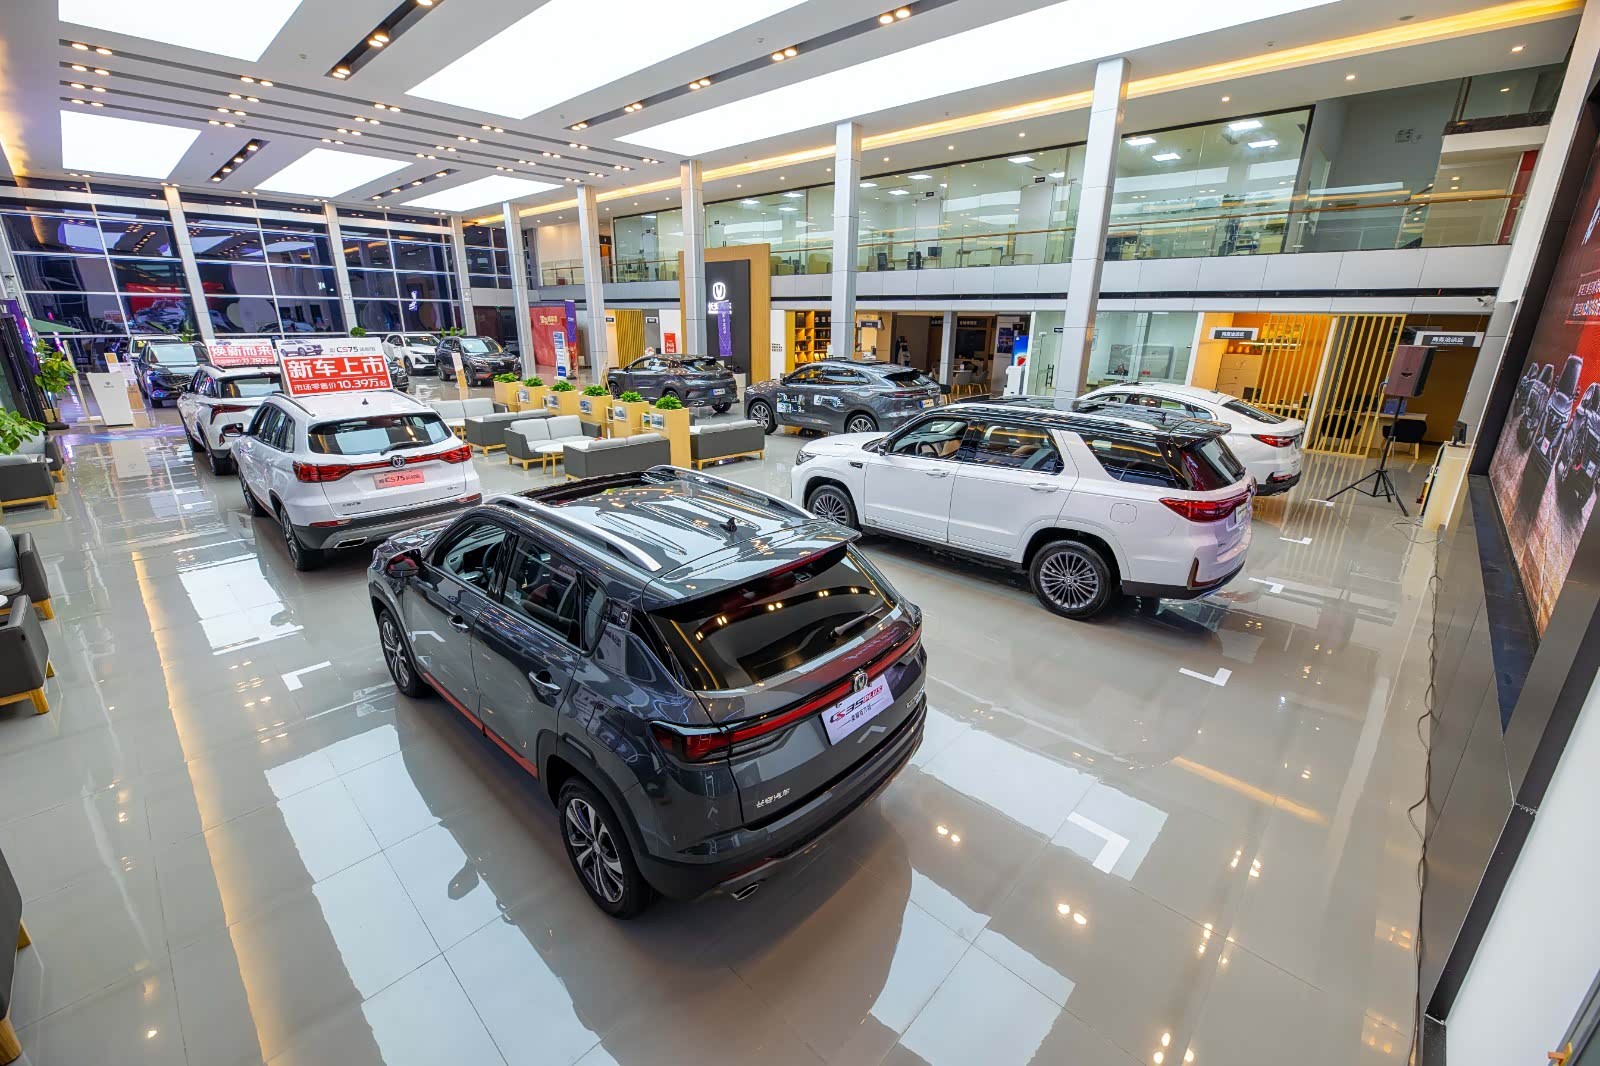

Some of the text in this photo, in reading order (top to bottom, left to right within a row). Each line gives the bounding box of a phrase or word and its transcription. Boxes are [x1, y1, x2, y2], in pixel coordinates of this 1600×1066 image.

[211, 345, 272, 357] 焕新而来
[287, 357, 385, 378] 新车上市
